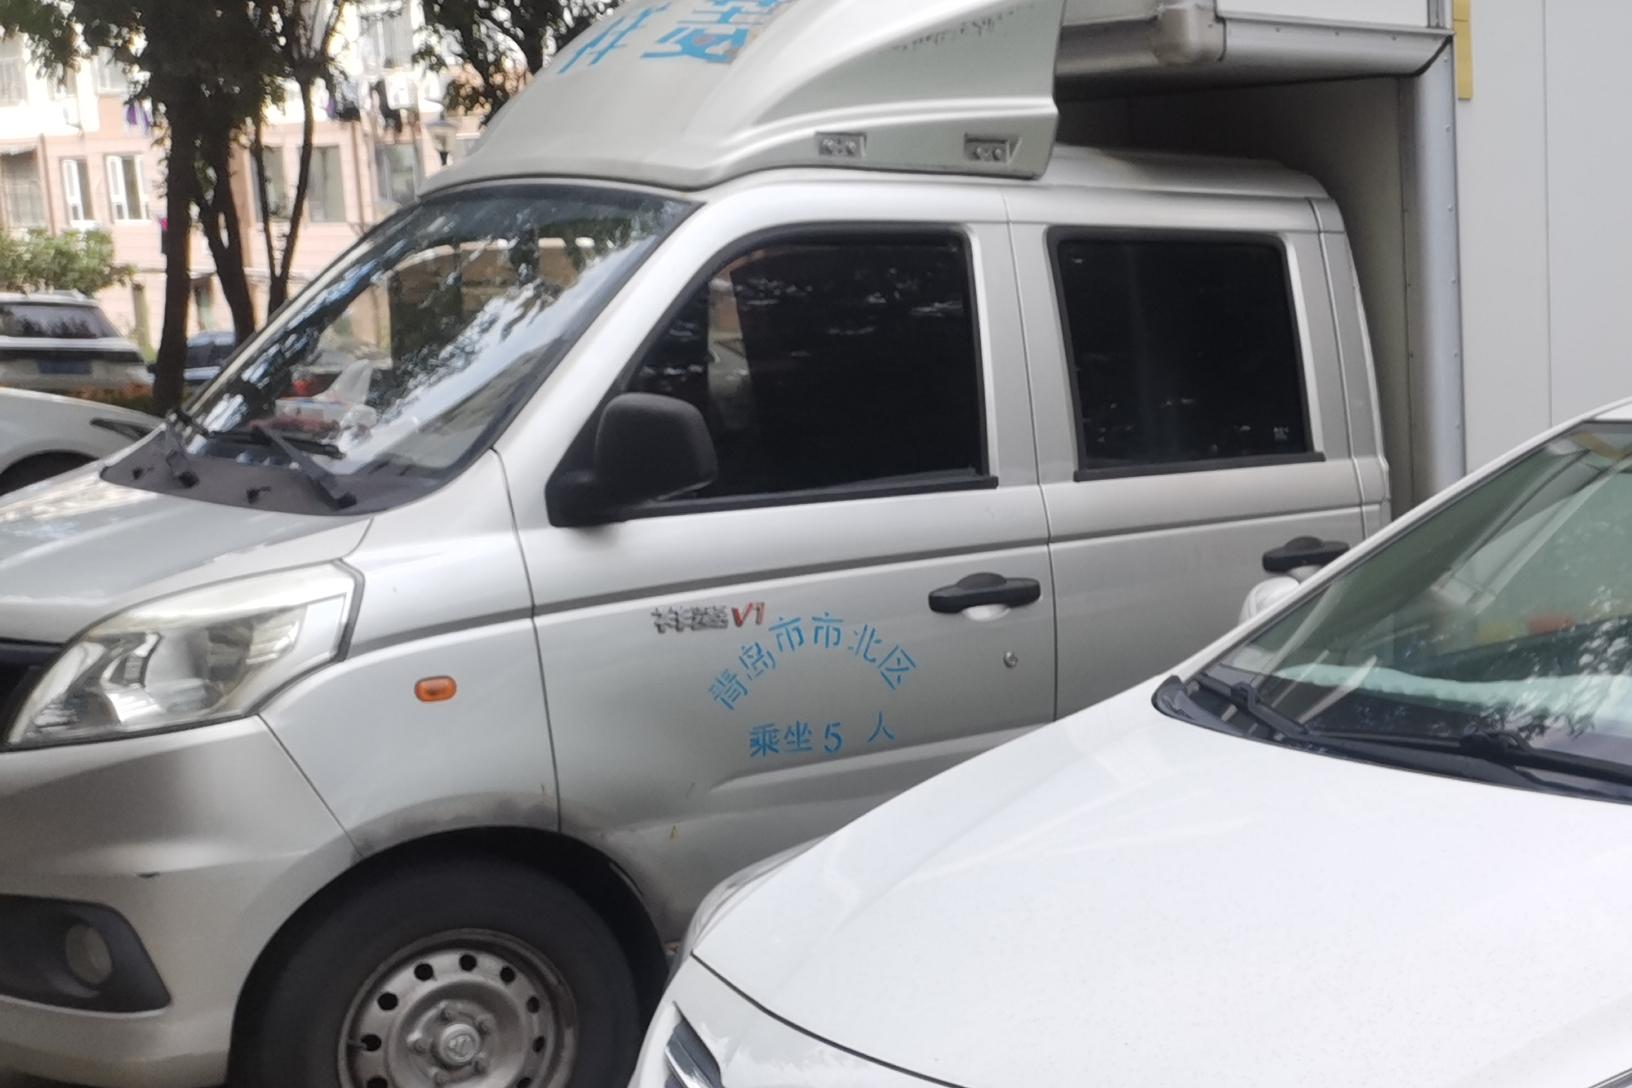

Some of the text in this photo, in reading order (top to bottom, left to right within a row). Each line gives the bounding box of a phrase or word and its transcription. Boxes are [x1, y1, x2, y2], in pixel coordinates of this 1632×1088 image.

[708, 612, 916, 710] 青岛市市北区
